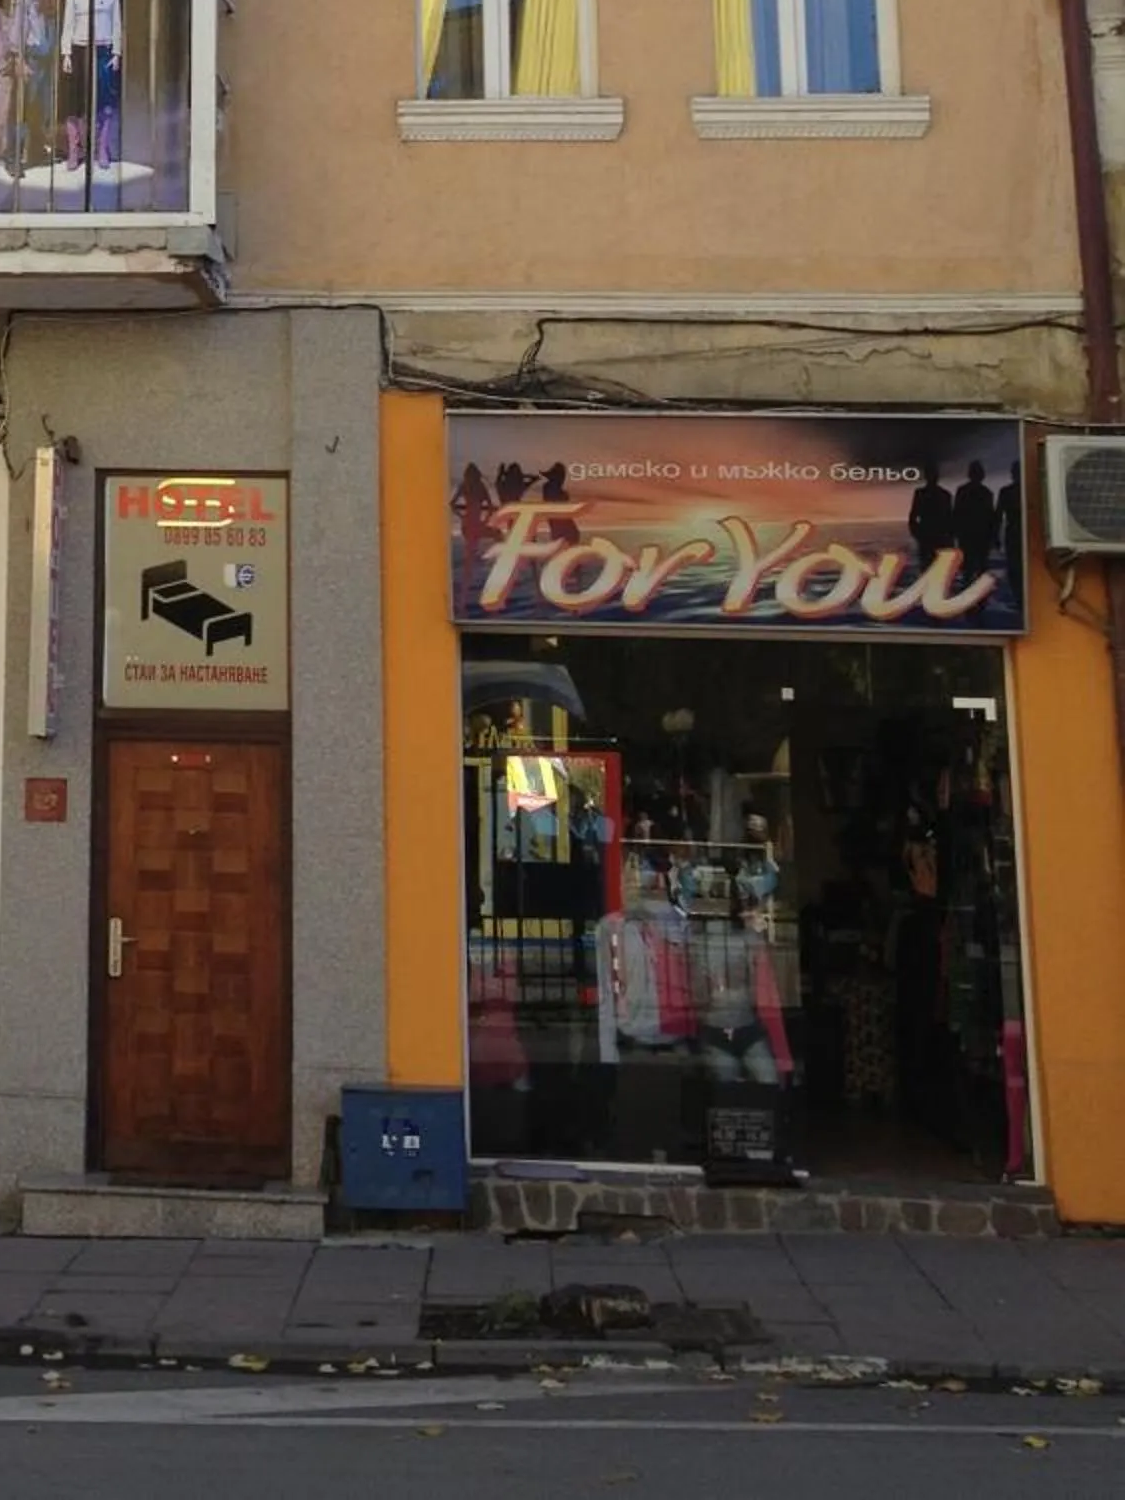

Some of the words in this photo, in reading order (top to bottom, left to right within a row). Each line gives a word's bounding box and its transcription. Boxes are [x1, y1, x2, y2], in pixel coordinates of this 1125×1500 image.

[568, 460, 681, 481] дамско
[718, 461, 821, 482] мъжко
[830, 461, 921, 483] бельо
[117, 484, 275, 521] HOTEL
[125, 663, 156, 681] СТАИ
[160, 664, 175, 682] ЗА
